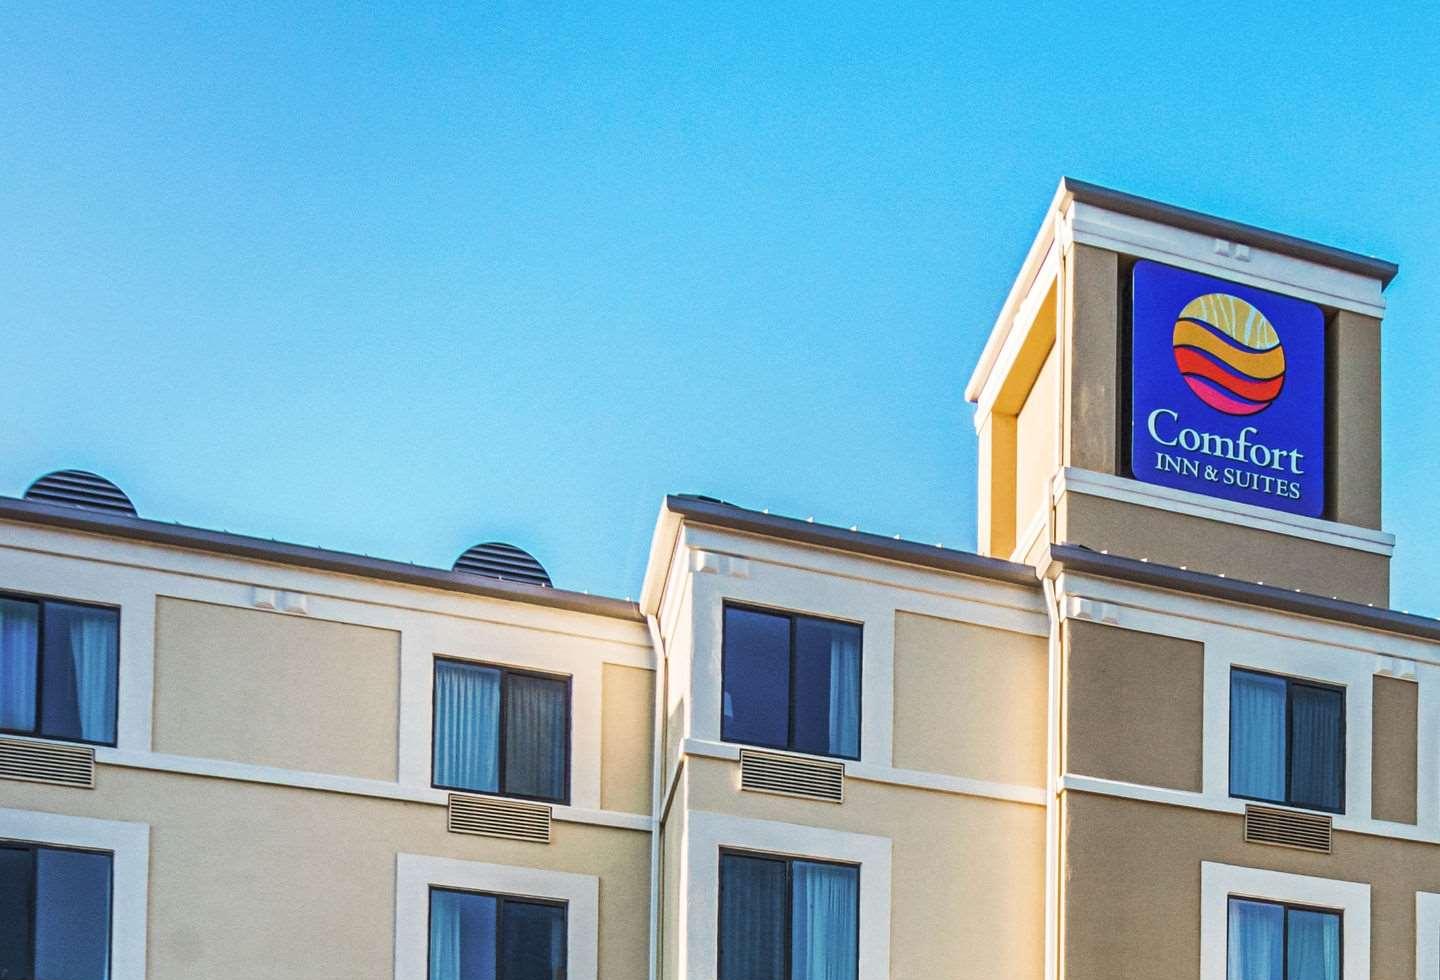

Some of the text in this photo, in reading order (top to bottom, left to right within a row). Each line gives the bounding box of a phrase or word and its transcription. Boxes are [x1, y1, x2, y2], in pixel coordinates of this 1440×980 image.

[1147, 408, 1305, 474] Comfort
[1155, 452, 1301, 500] INN & SUITES
